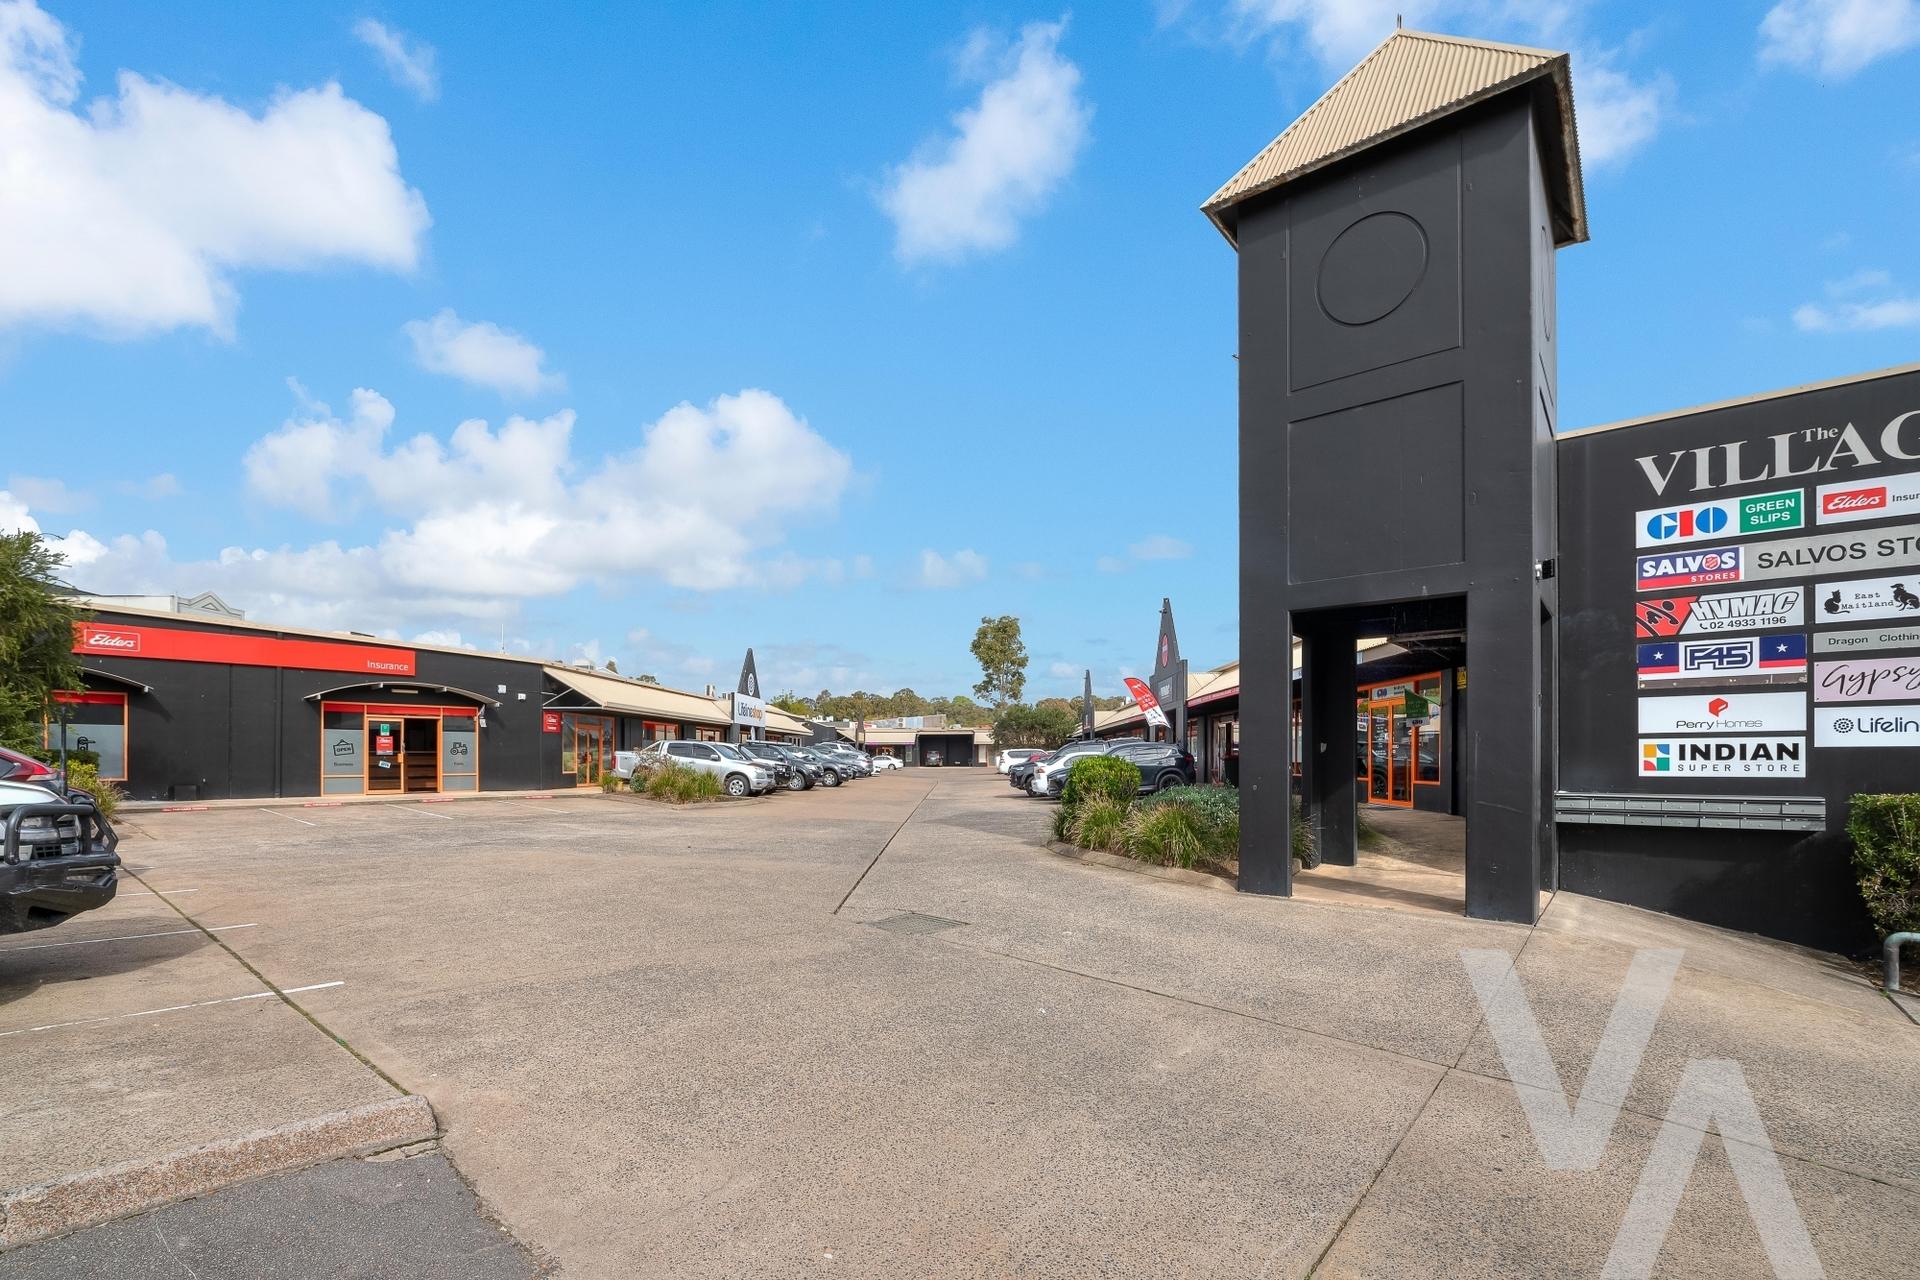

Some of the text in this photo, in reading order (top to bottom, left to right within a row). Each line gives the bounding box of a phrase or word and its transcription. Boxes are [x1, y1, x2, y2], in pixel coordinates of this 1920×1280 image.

[1801, 427, 1839, 443] The
[1745, 498, 1795, 514] GREEN
[1827, 494, 1881, 510] Elders
[1647, 507, 1728, 540] GIO
[1750, 511, 1791, 525] SLIPS
[1757, 536, 1920, 569] SALVOS ST
[1642, 552, 1736, 578] SALVOS
[1691, 572, 1735, 583] STORES
[1854, 592, 1881, 600] East
[1689, 591, 1799, 621] HVMAC
[1841, 600, 1894, 610] Maitland
[1709, 616, 1787, 630] 02 4933 1196
[89, 634, 136, 647] Elders
[1828, 635, 1868, 646] Dragon
[1684, 641, 1753, 670] F45
[367, 660, 409, 671] Insurance
[1678, 743, 1800, 761] INDIAN
[1678, 764, 1800, 772] SUPER STORE
